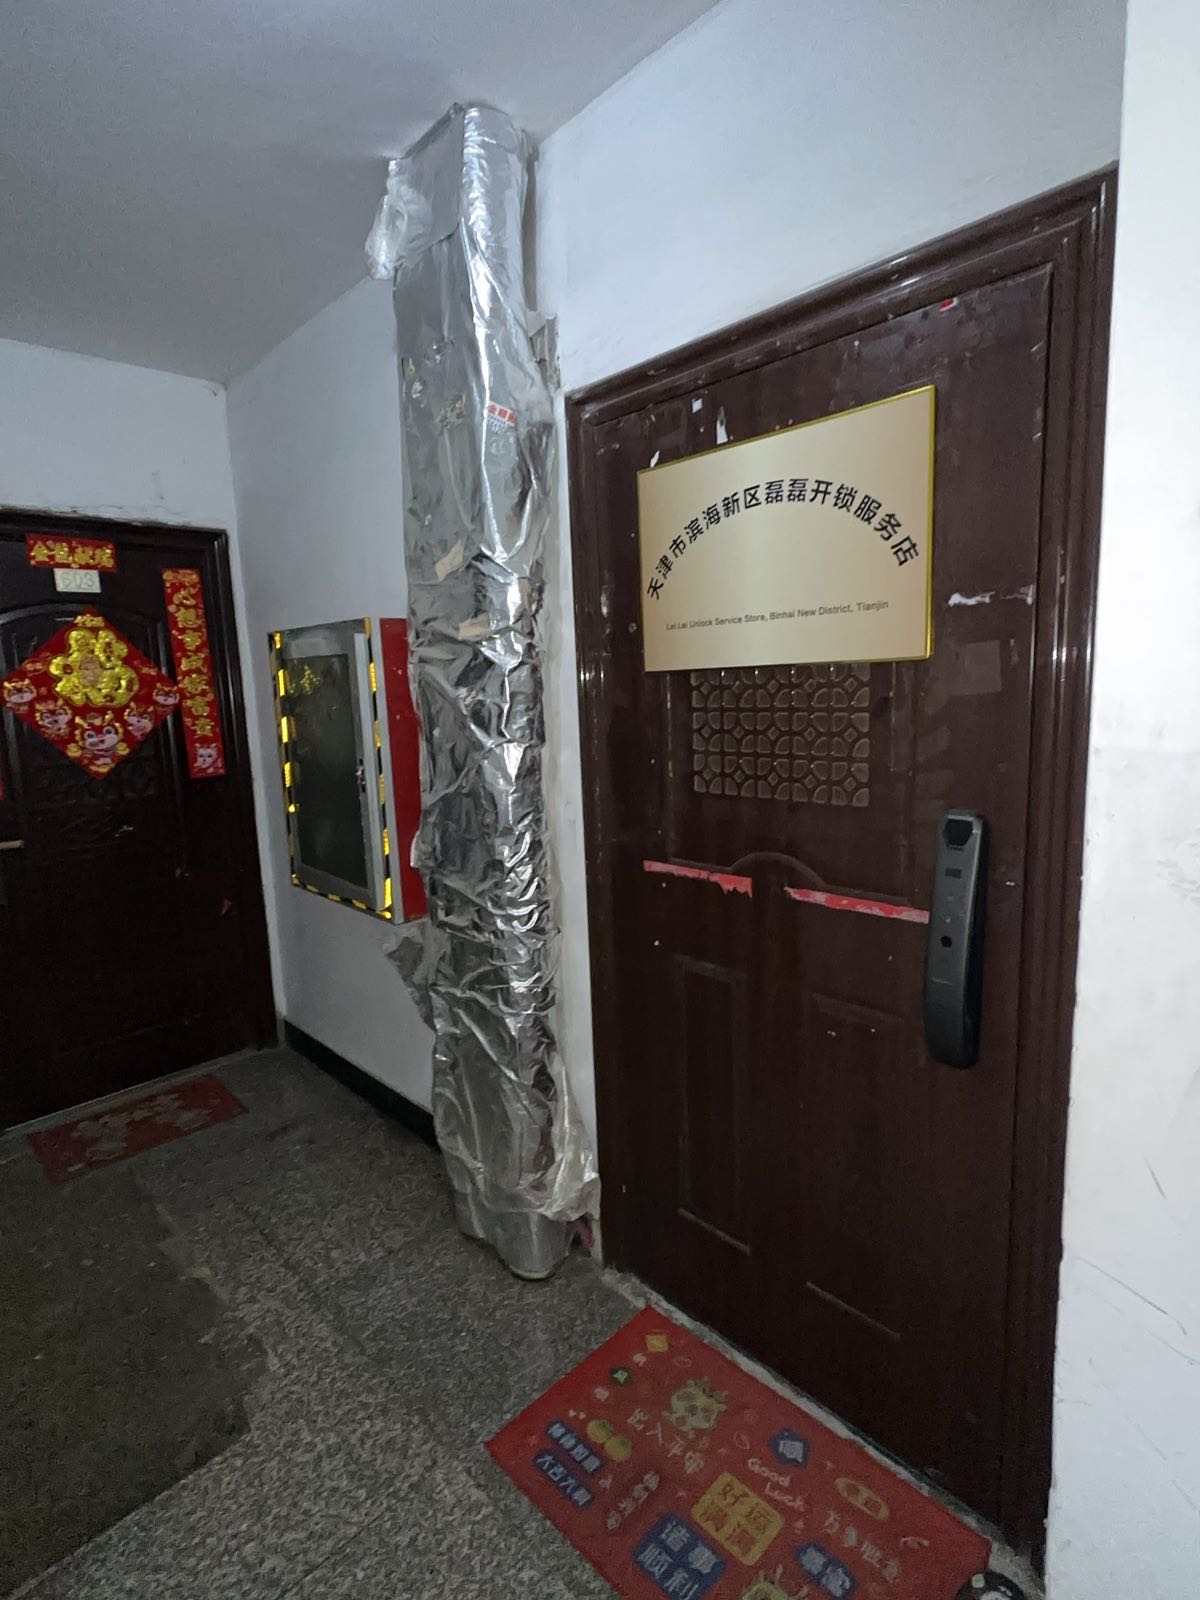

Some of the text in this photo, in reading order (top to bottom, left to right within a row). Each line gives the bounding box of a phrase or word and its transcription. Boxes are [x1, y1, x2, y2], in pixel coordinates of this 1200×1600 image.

[646, 478, 919, 600] 天津市滨海新区磊磊开锁服务店
[714, 616, 742, 626] Service
[769, 608, 796, 621] Binhai
[797, 608, 817, 618] New
[856, 599, 889, 612] Tianjin
